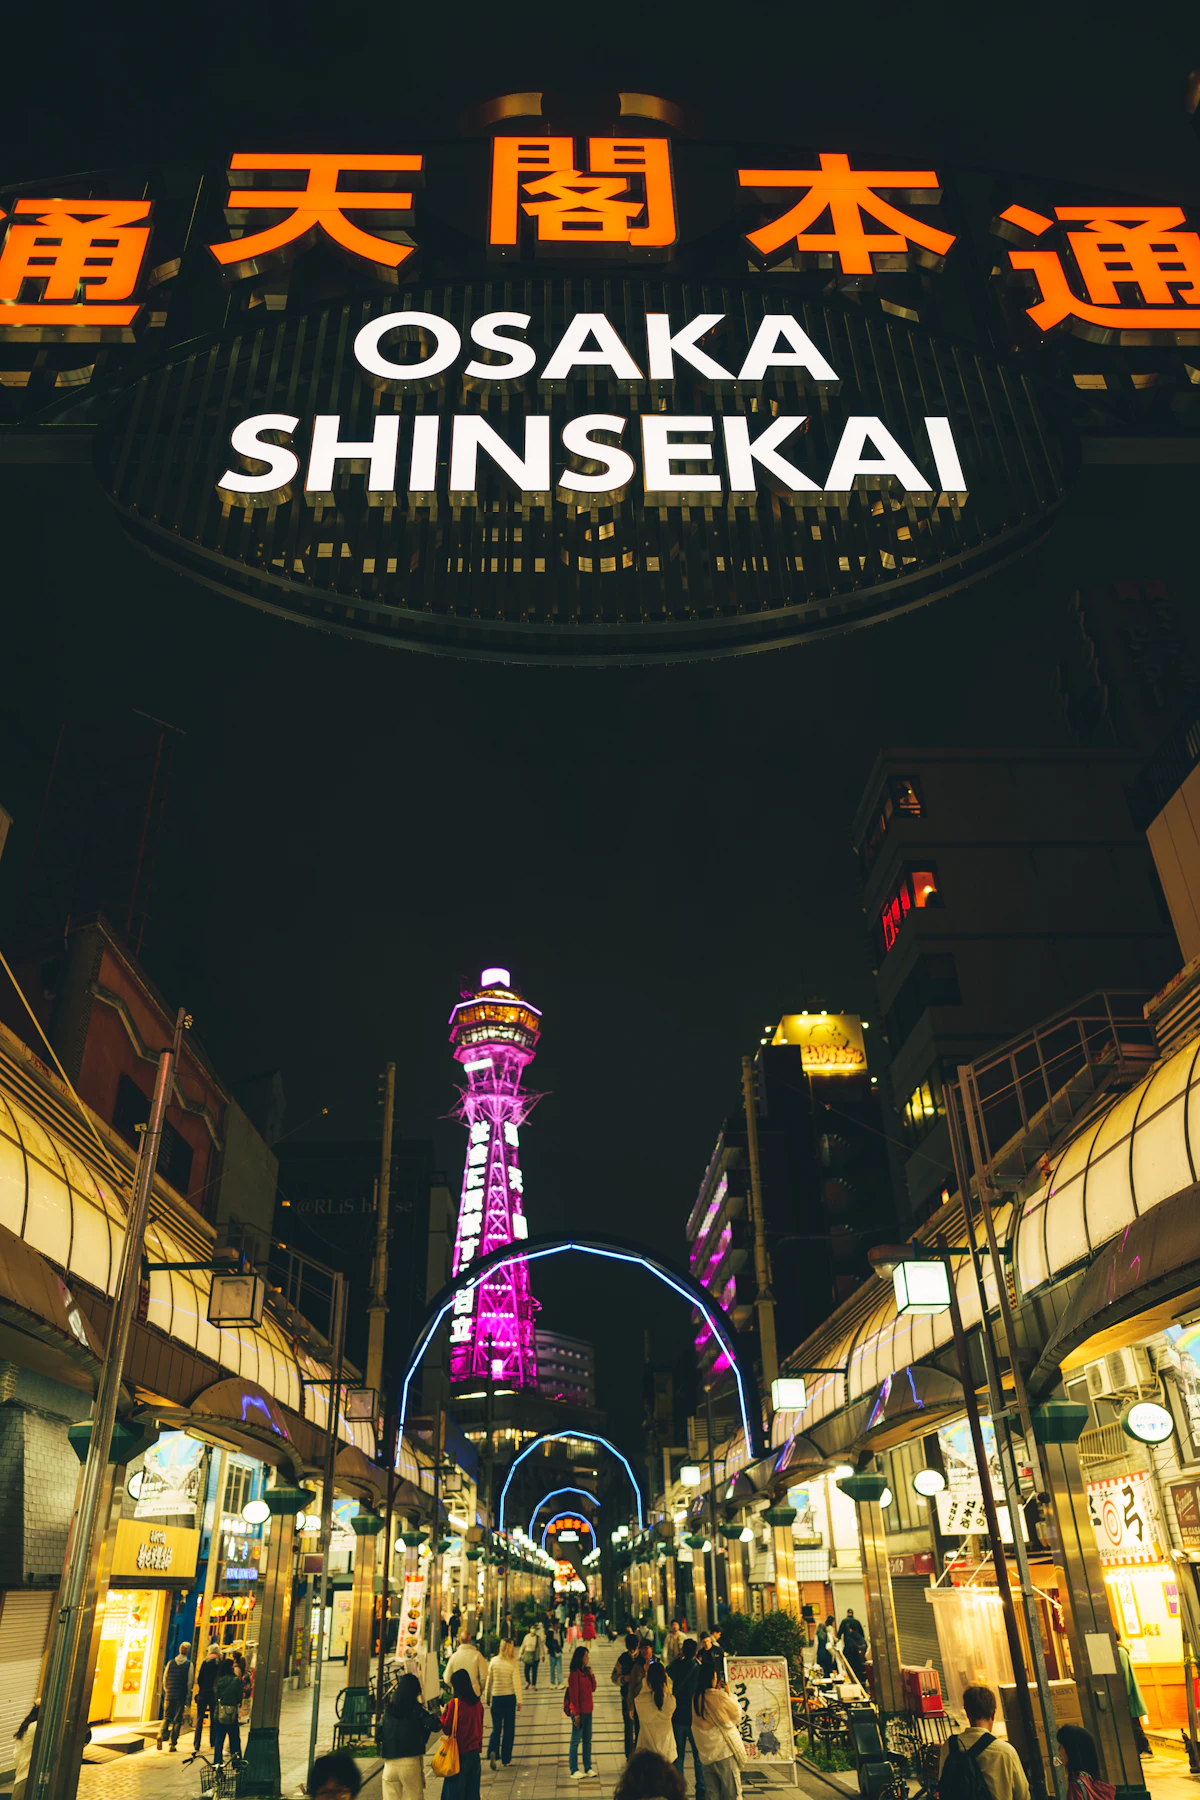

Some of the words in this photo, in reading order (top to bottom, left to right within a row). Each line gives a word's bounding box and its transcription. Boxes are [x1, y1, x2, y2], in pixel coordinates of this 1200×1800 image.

[354, 311, 839, 382] OSAKA
[217, 413, 968, 494] SHINSEKAI
[729, 1664, 783, 1681] SAMURAI
[734, 1682, 756, 1743] 弓道
